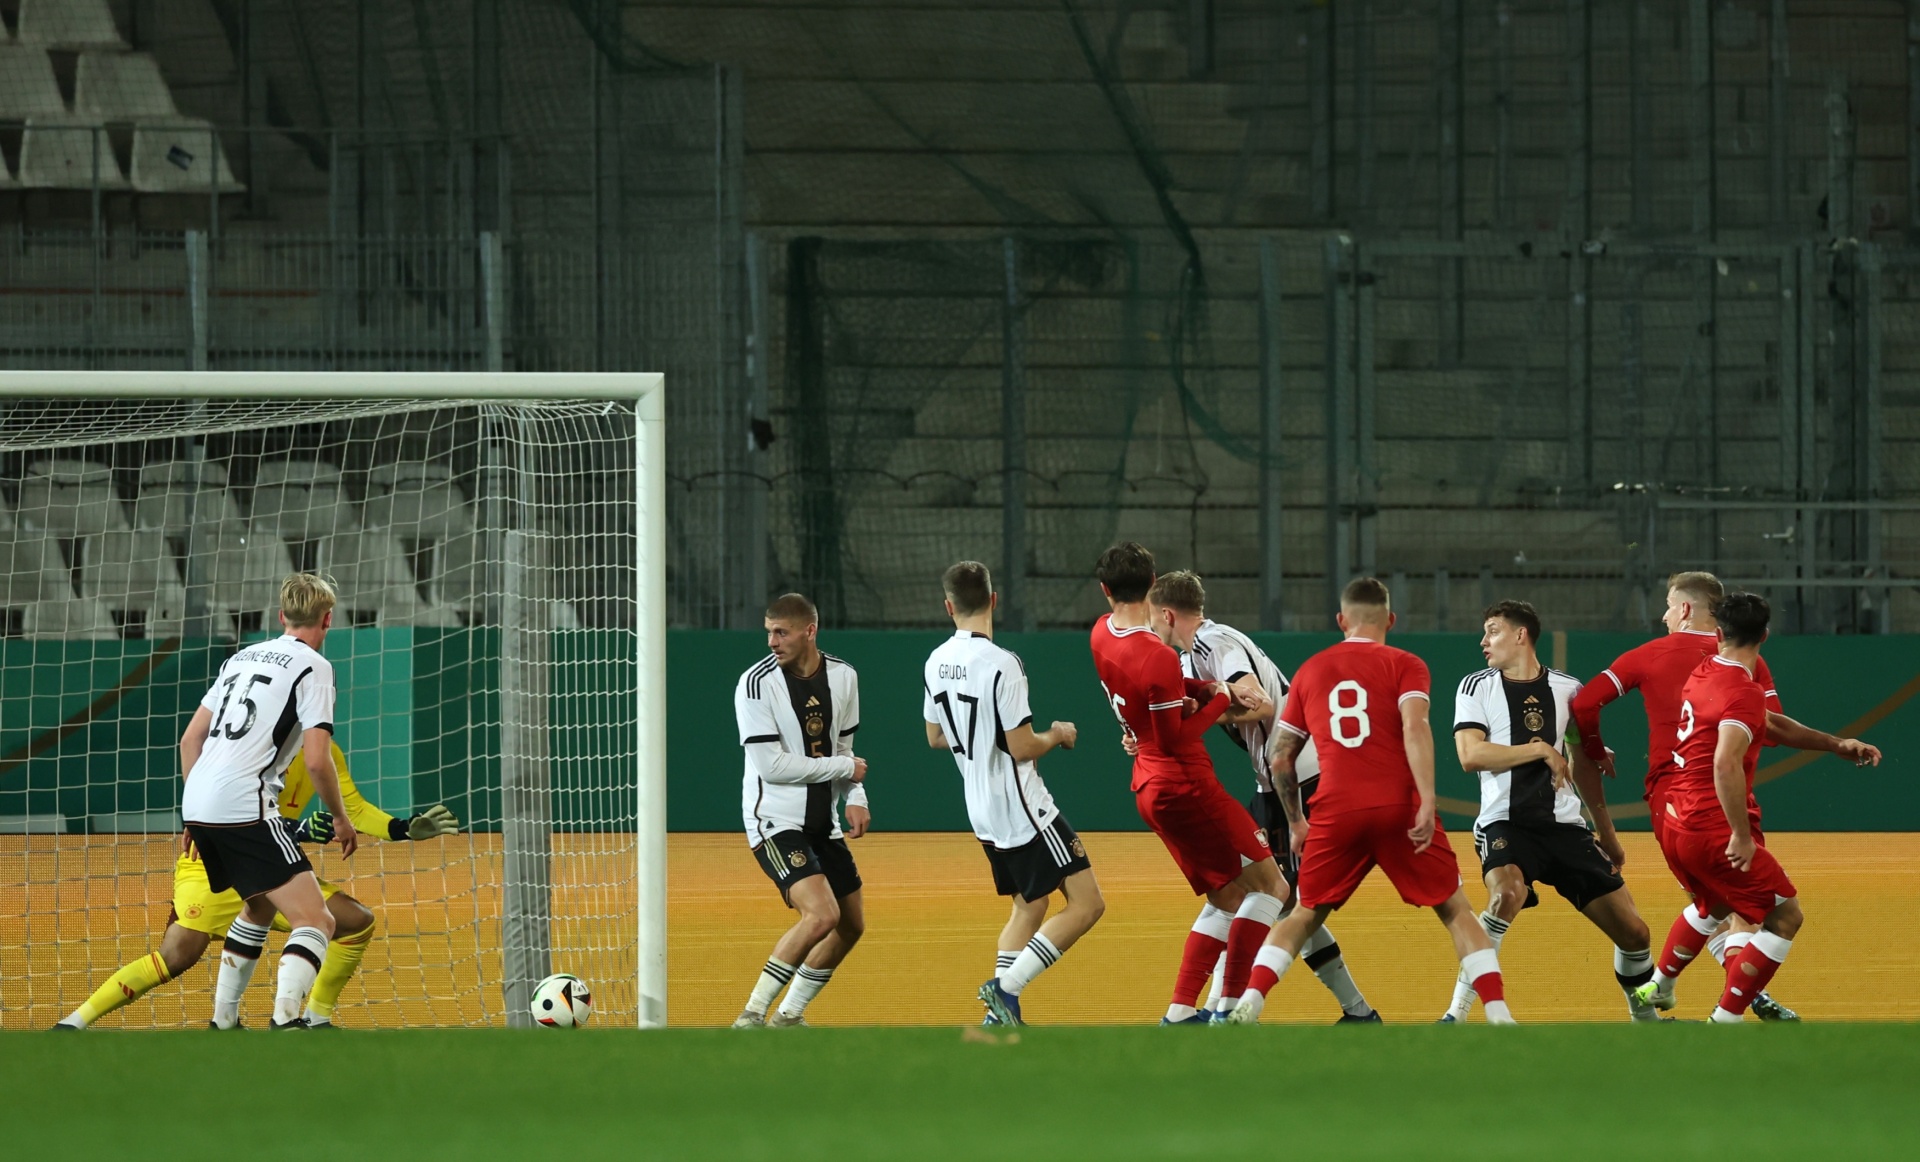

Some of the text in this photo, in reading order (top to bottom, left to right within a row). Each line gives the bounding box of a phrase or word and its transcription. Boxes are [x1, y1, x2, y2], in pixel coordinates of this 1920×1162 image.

[209, 672, 273, 740] 15
[938, 664, 968, 681] GRUDA
[933, 690, 979, 761] 17
[1328, 679, 1371, 748] 8
[811, 740, 825, 758] 5
